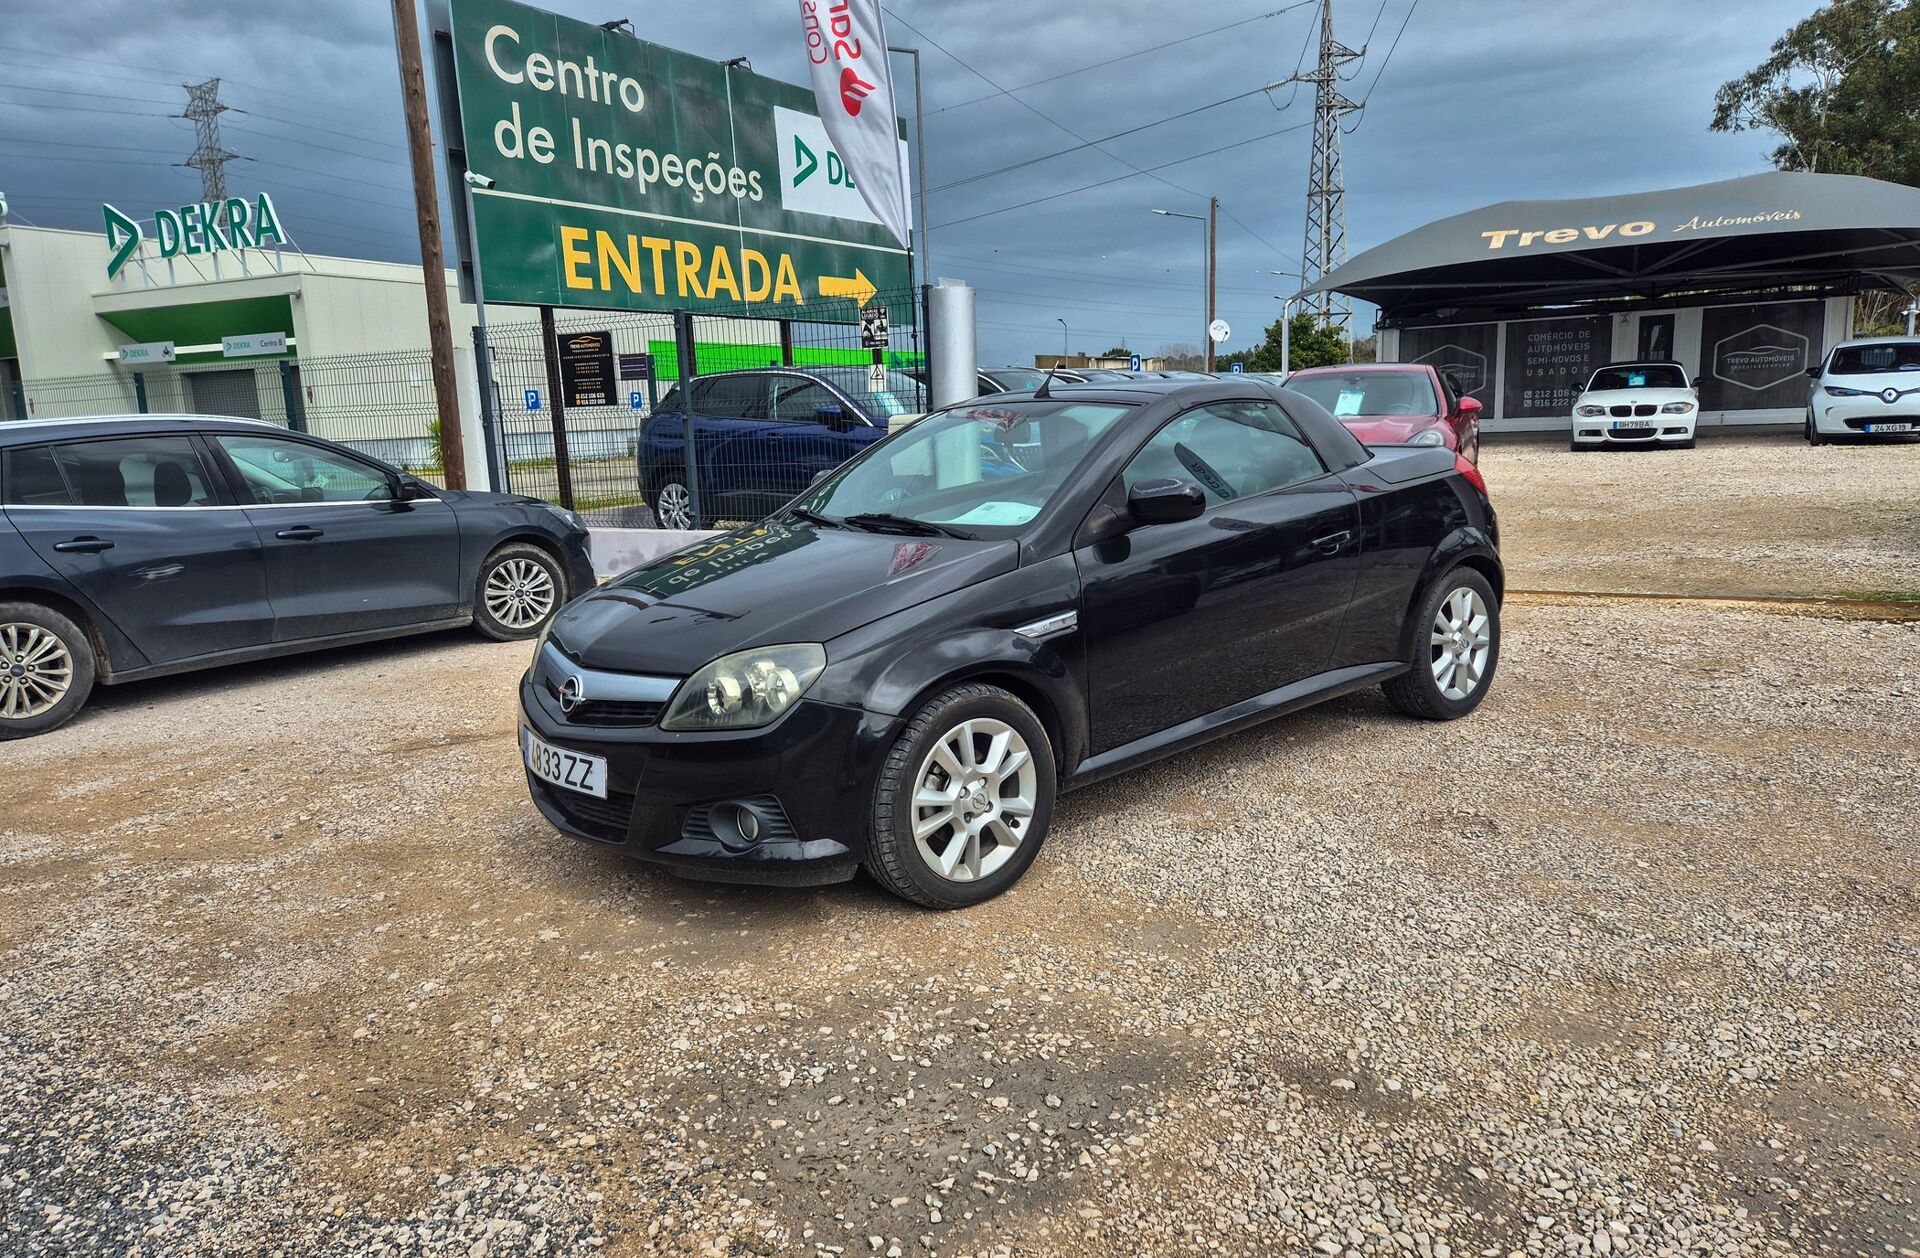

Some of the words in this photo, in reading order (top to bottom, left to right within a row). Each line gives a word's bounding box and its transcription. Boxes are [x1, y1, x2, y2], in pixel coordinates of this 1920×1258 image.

[484, 24, 645, 113] Centro
[494, 101, 556, 164] de
[572, 117, 764, 203] Inspeções
[154, 192, 287, 259] DEKRA
[1480, 219, 1656, 251] Trevo
[1672, 210, 1803, 233] Automóveis
[560, 225, 804, 306] ENTRADA
[1528, 331, 1574, 342] COMÉRCIO
[1578, 330, 1591, 338] DE
[233, 341, 251, 350] DEKRA
[259, 339, 278, 348] Centro
[1527, 342, 1590, 354] AUTOMÓVEIS
[129, 348, 149, 357] DEKRA
[1750, 354, 1795, 363] AUTOMÓVEIS
[1527, 354, 1582, 365] SEMI-NOVOS
[1583, 354, 1589, 362] E
[1534, 390, 1551, 398] 212
[1553, 389, 1569, 397] 106
[1534, 399, 1550, 407] 916
[1552, 398, 1569, 406] 222
